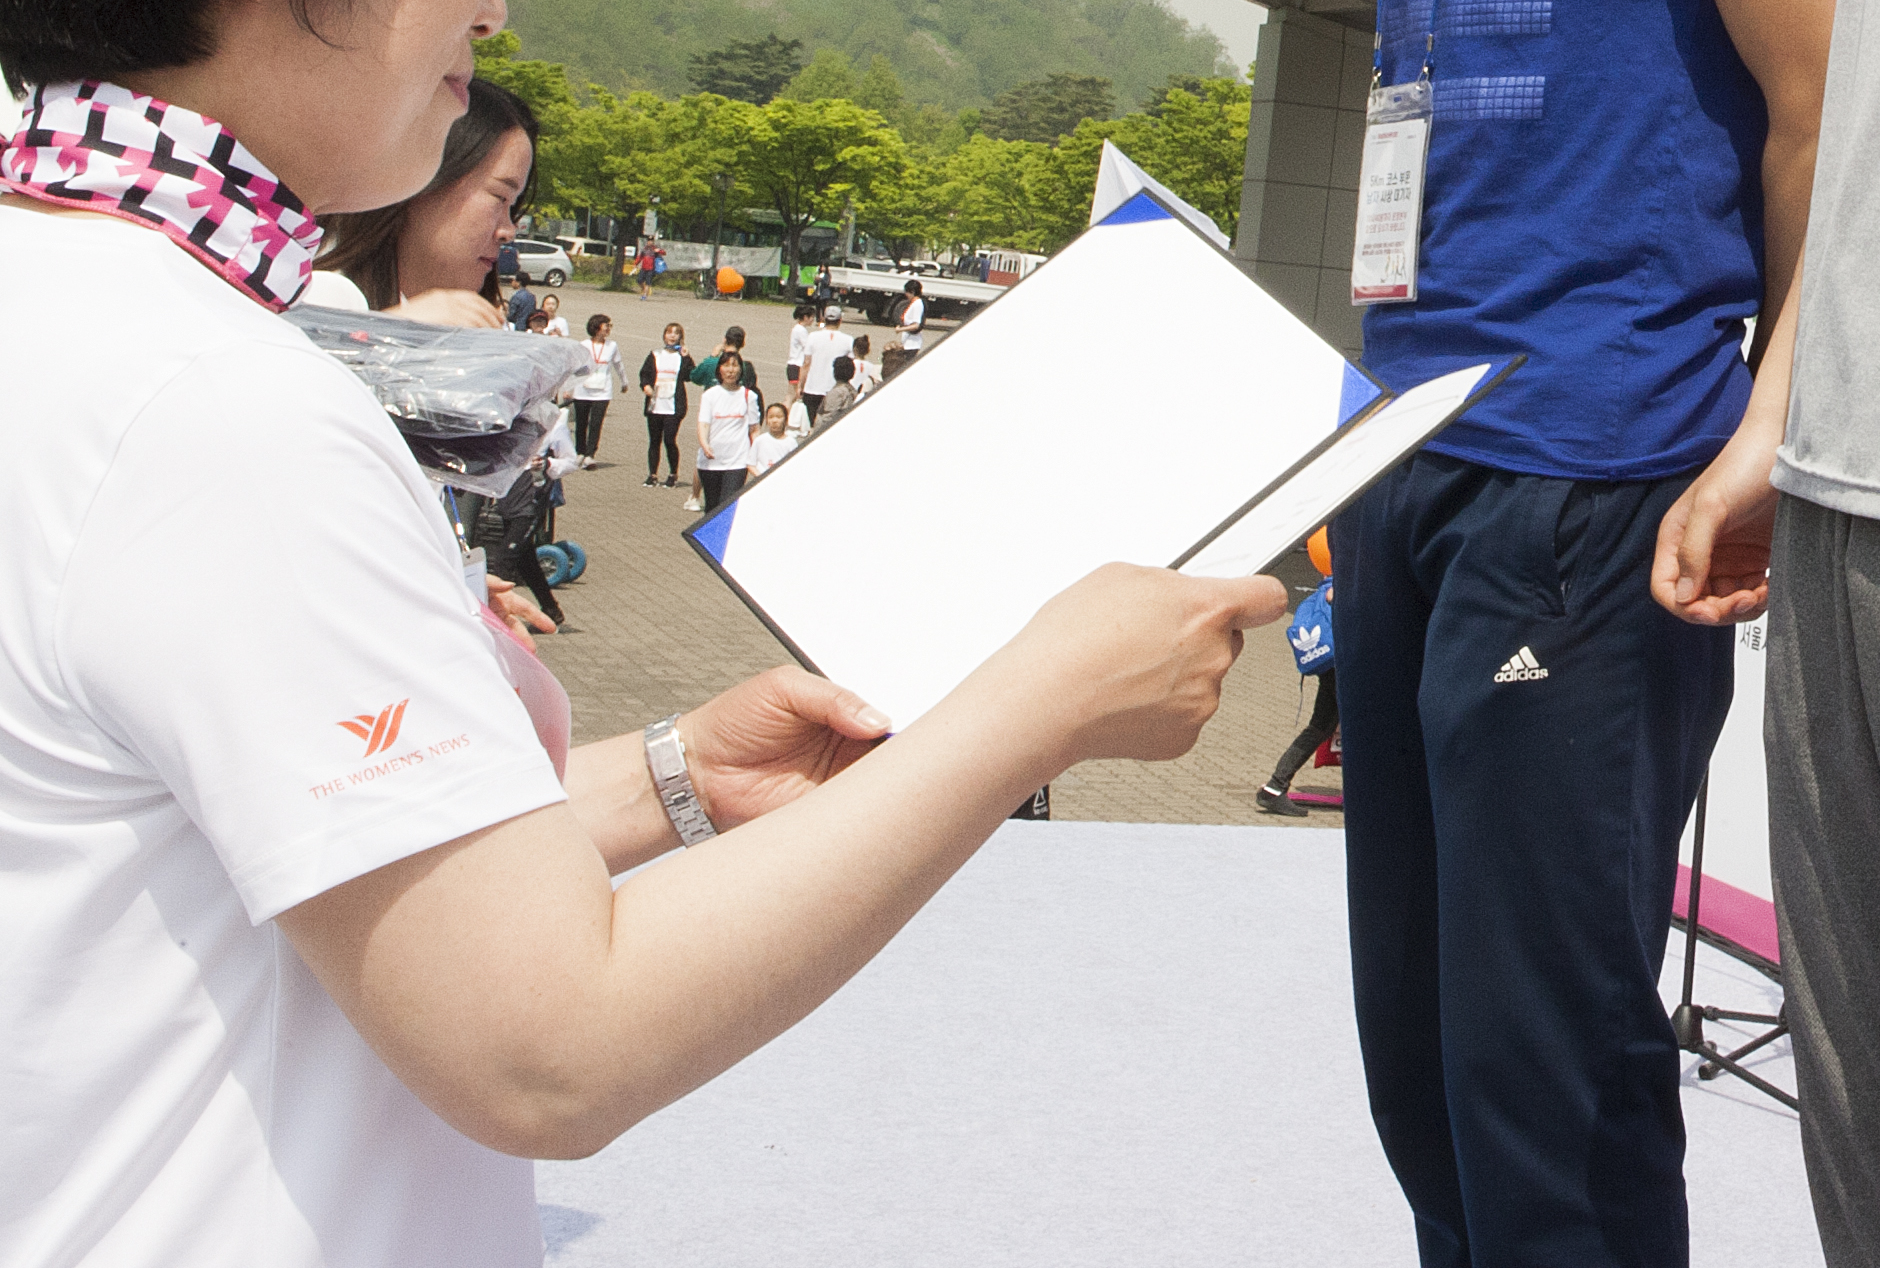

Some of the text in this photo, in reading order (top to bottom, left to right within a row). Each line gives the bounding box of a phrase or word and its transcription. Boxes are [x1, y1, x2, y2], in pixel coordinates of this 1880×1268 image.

[1300, 645, 1330, 664] adidas
[1494, 668, 1548, 683] adidas
[309, 734, 470, 800] THE WOMEN'S NEWS
